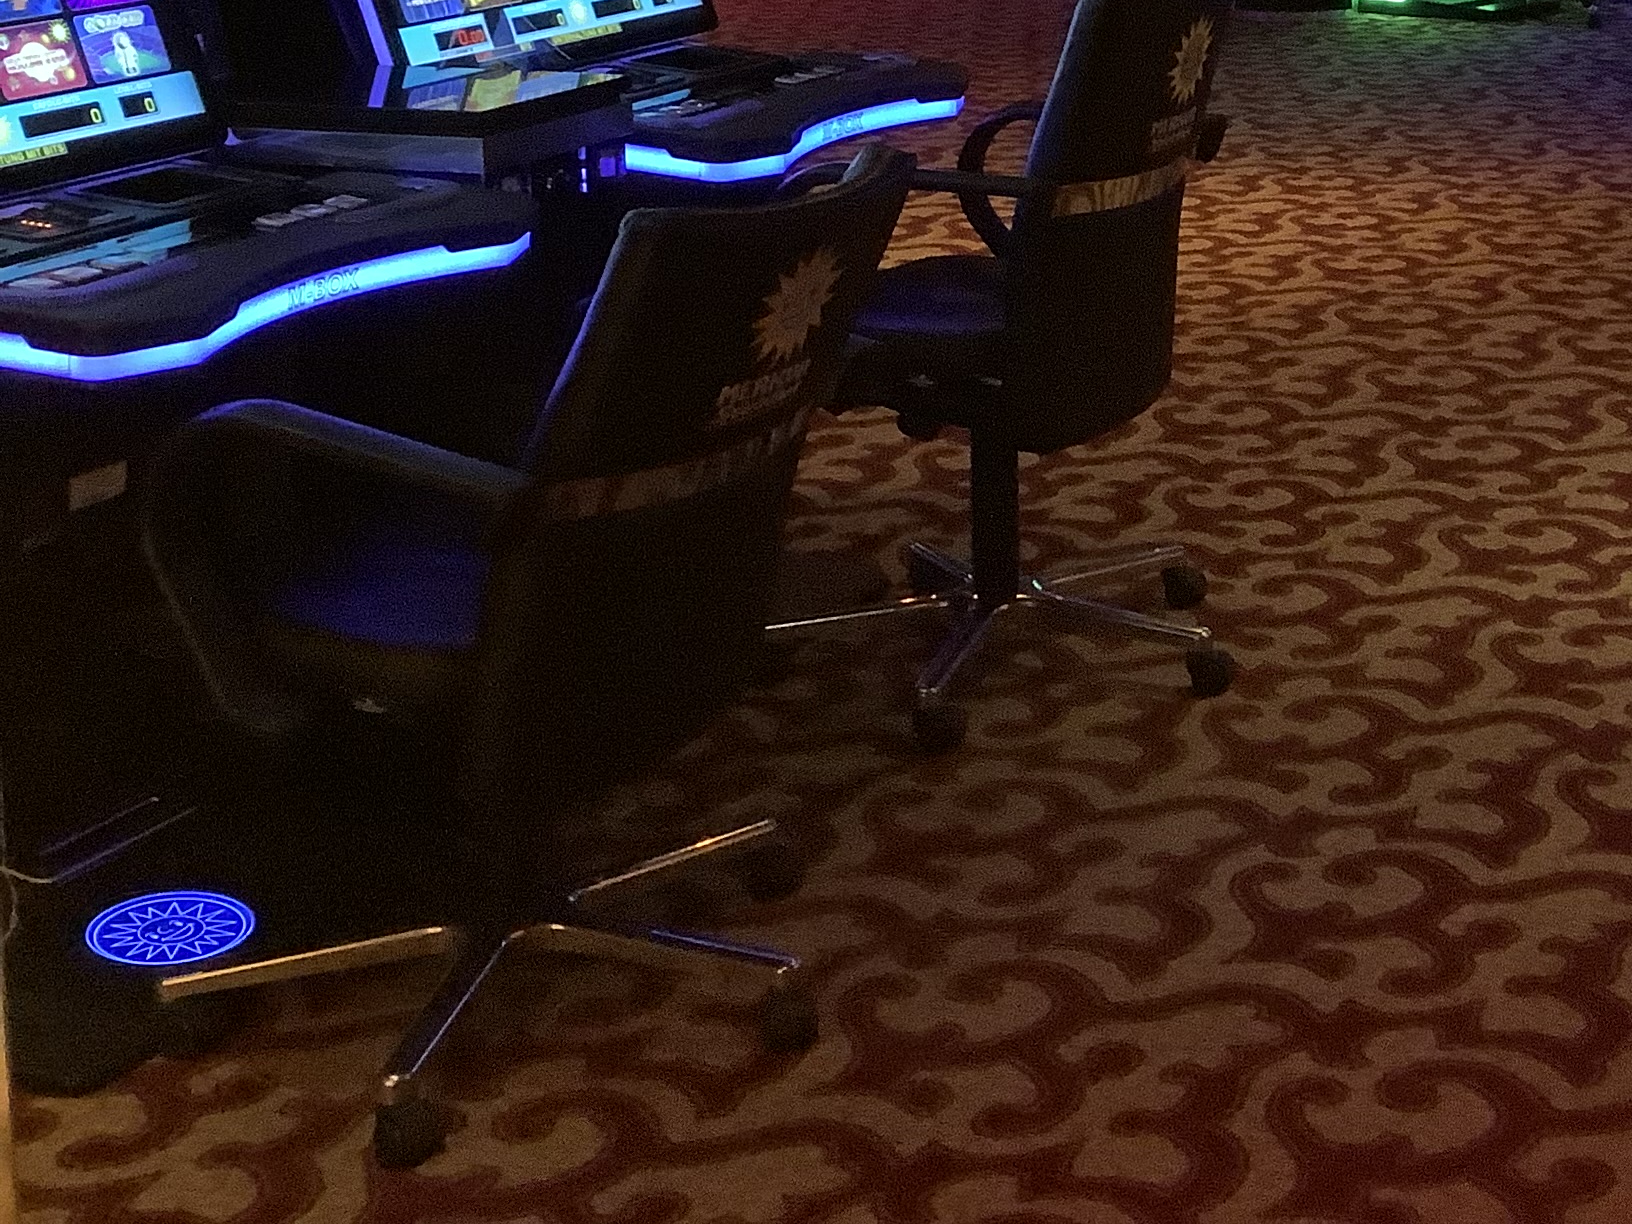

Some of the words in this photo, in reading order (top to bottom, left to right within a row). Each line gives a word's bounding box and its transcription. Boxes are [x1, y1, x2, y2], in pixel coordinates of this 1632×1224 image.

[144, 97, 156, 113] 0
[90, 107, 102, 124] 0
[286, 267, 361, 311] M-BOX
